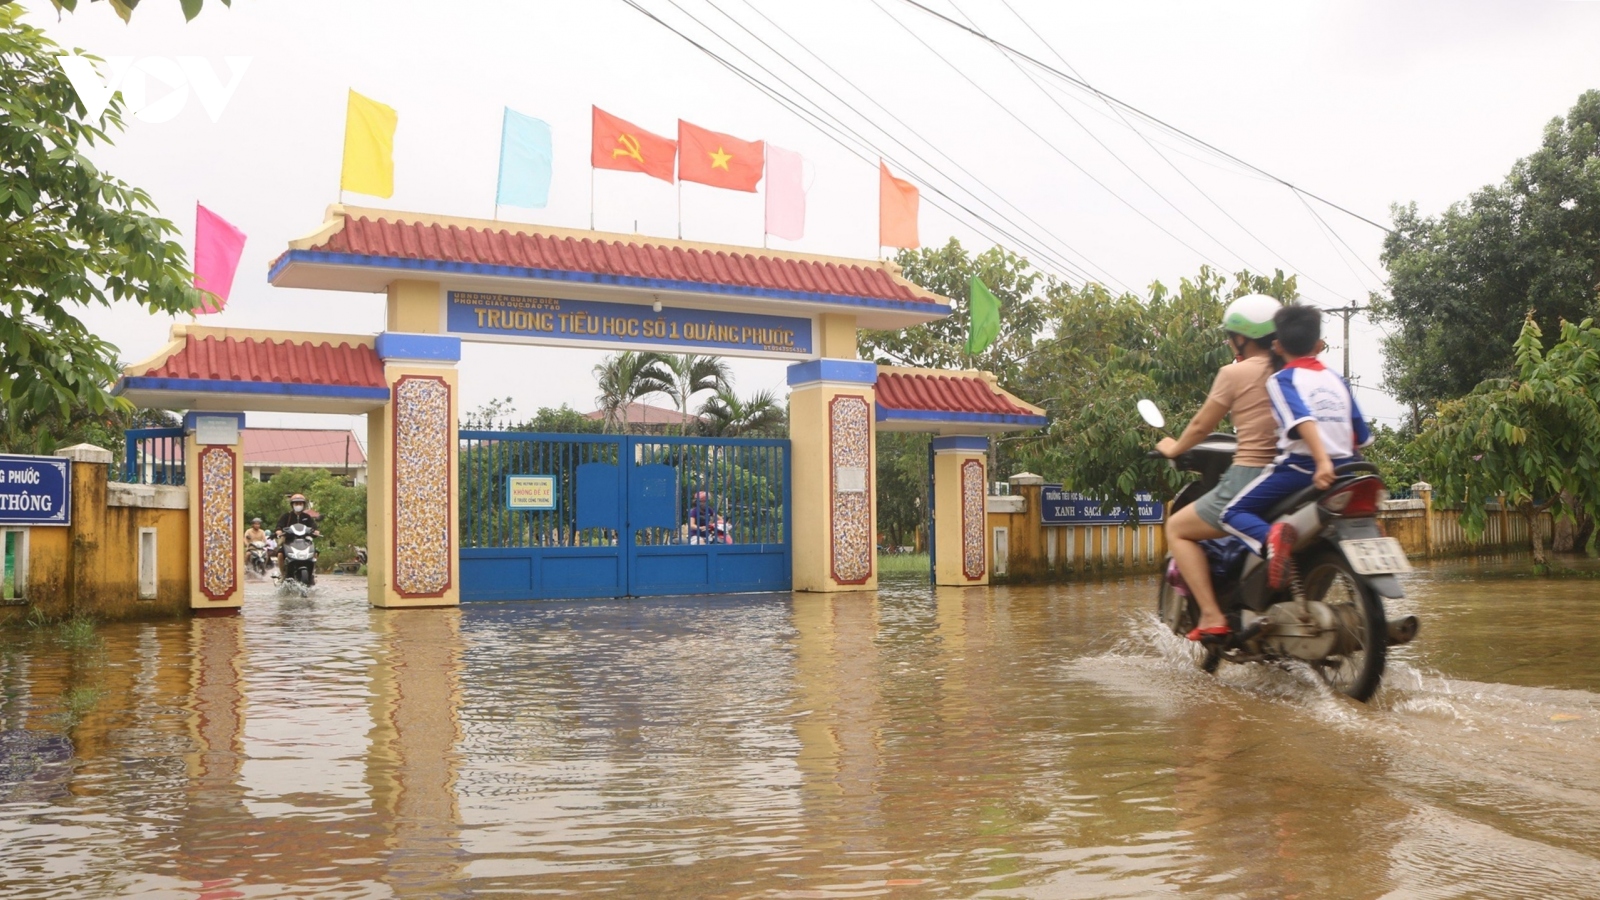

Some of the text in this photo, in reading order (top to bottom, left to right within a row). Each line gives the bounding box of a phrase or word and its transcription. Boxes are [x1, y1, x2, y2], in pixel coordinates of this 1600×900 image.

[454, 292, 479, 300] UBND
[474, 307, 794, 347] TRƯỜNG TIỂU HỌC SỐ 1 QUẢNG PHƯỚC
[8, 466, 40, 485] PHƯỚC
[0, 490, 52, 511] THÔNG
[1046, 490, 1061, 501] TRƯỜNG
[1055, 506, 1075, 516] XANH
[1138, 504, 1153, 516] TOÀN
